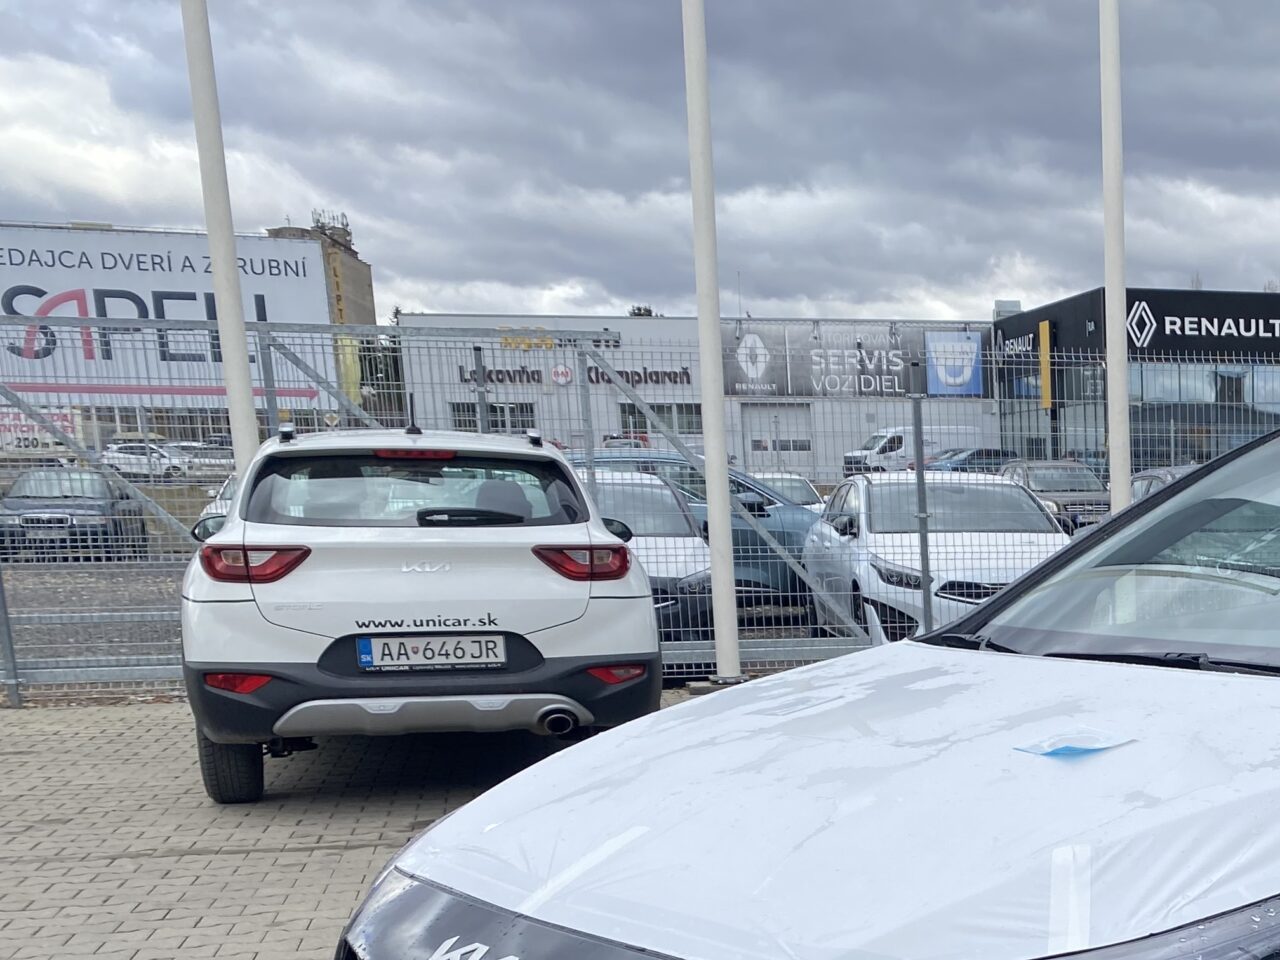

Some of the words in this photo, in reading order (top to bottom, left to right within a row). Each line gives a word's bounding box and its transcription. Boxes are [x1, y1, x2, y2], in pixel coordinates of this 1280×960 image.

[101, 250, 173, 272] DVERÍ
[181, 255, 196, 273] A
[202, 255, 308, 277] ZRUBNÍ
[810, 348, 904, 370] SERVIS
[735, 382, 777, 390] RENAULT
[811, 374, 905, 393] VOZIDIEL
[15, 437, 39, 448] 200
[401, 561, 451, 573] KIA
[355, 612, 499, 629] www.unicar.sk
[380, 642, 410, 662] AA
